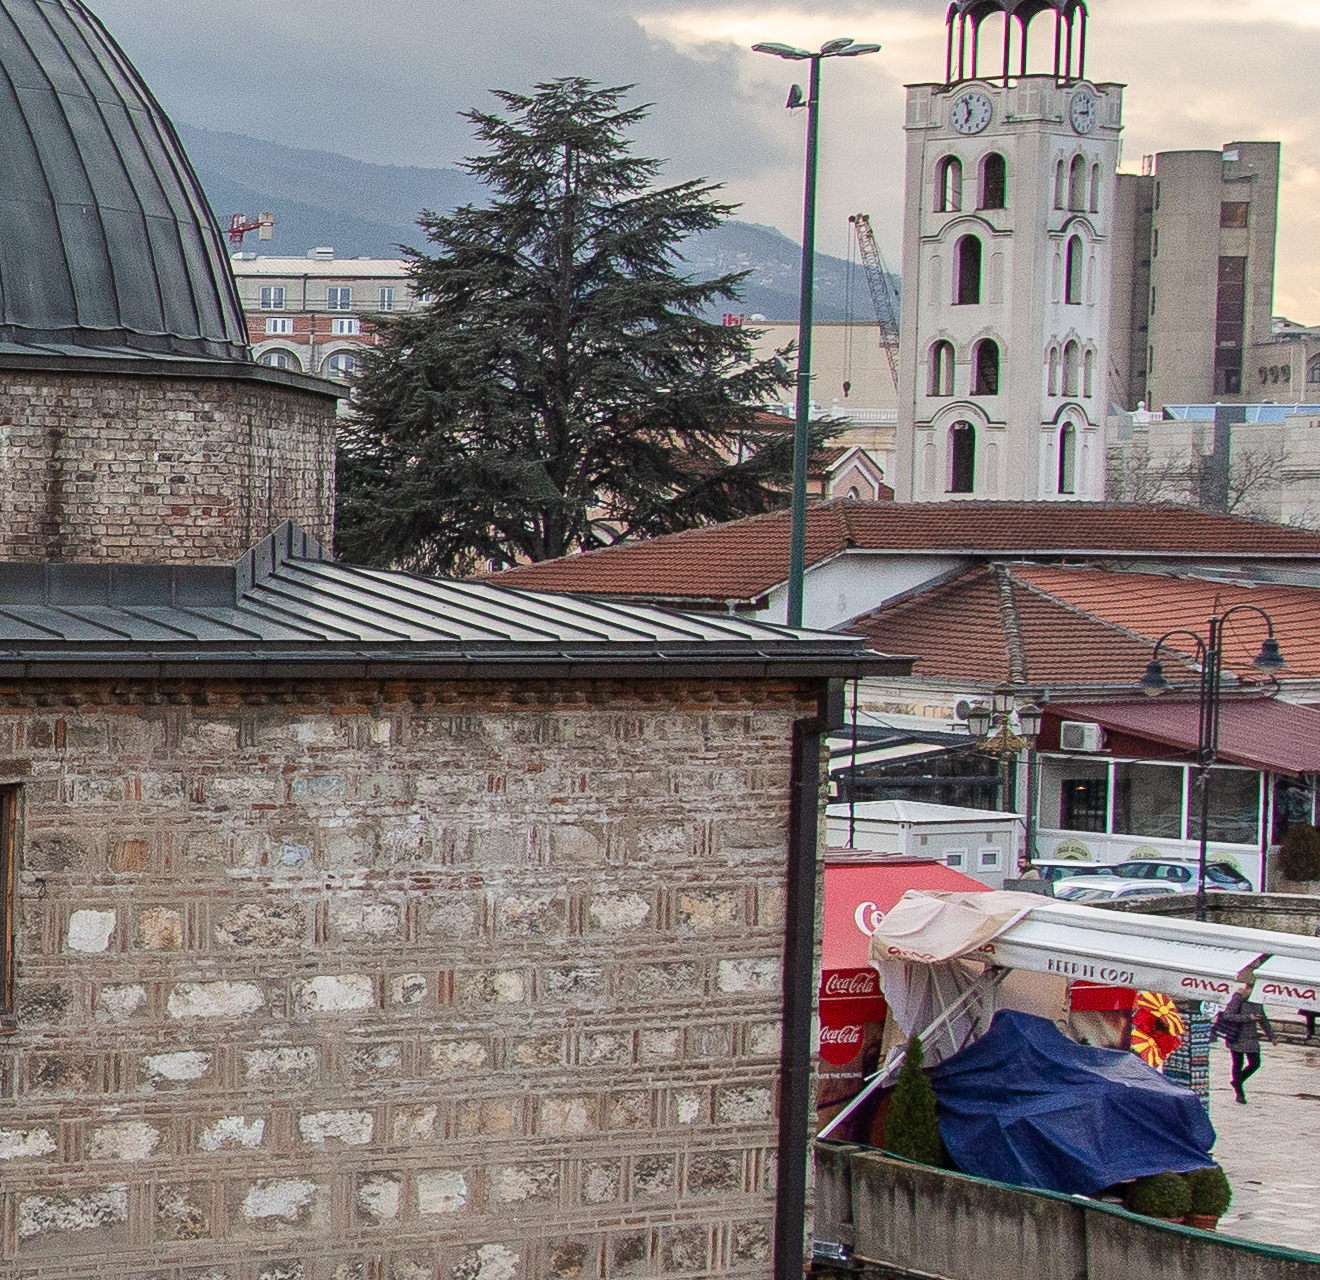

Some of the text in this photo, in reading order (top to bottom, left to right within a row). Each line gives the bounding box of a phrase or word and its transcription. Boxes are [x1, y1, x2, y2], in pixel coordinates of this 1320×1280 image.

[1047, 958, 1079, 974] KEEP
[1181, 976, 1230, 995] ama
[1262, 983, 1317, 1001] ama
